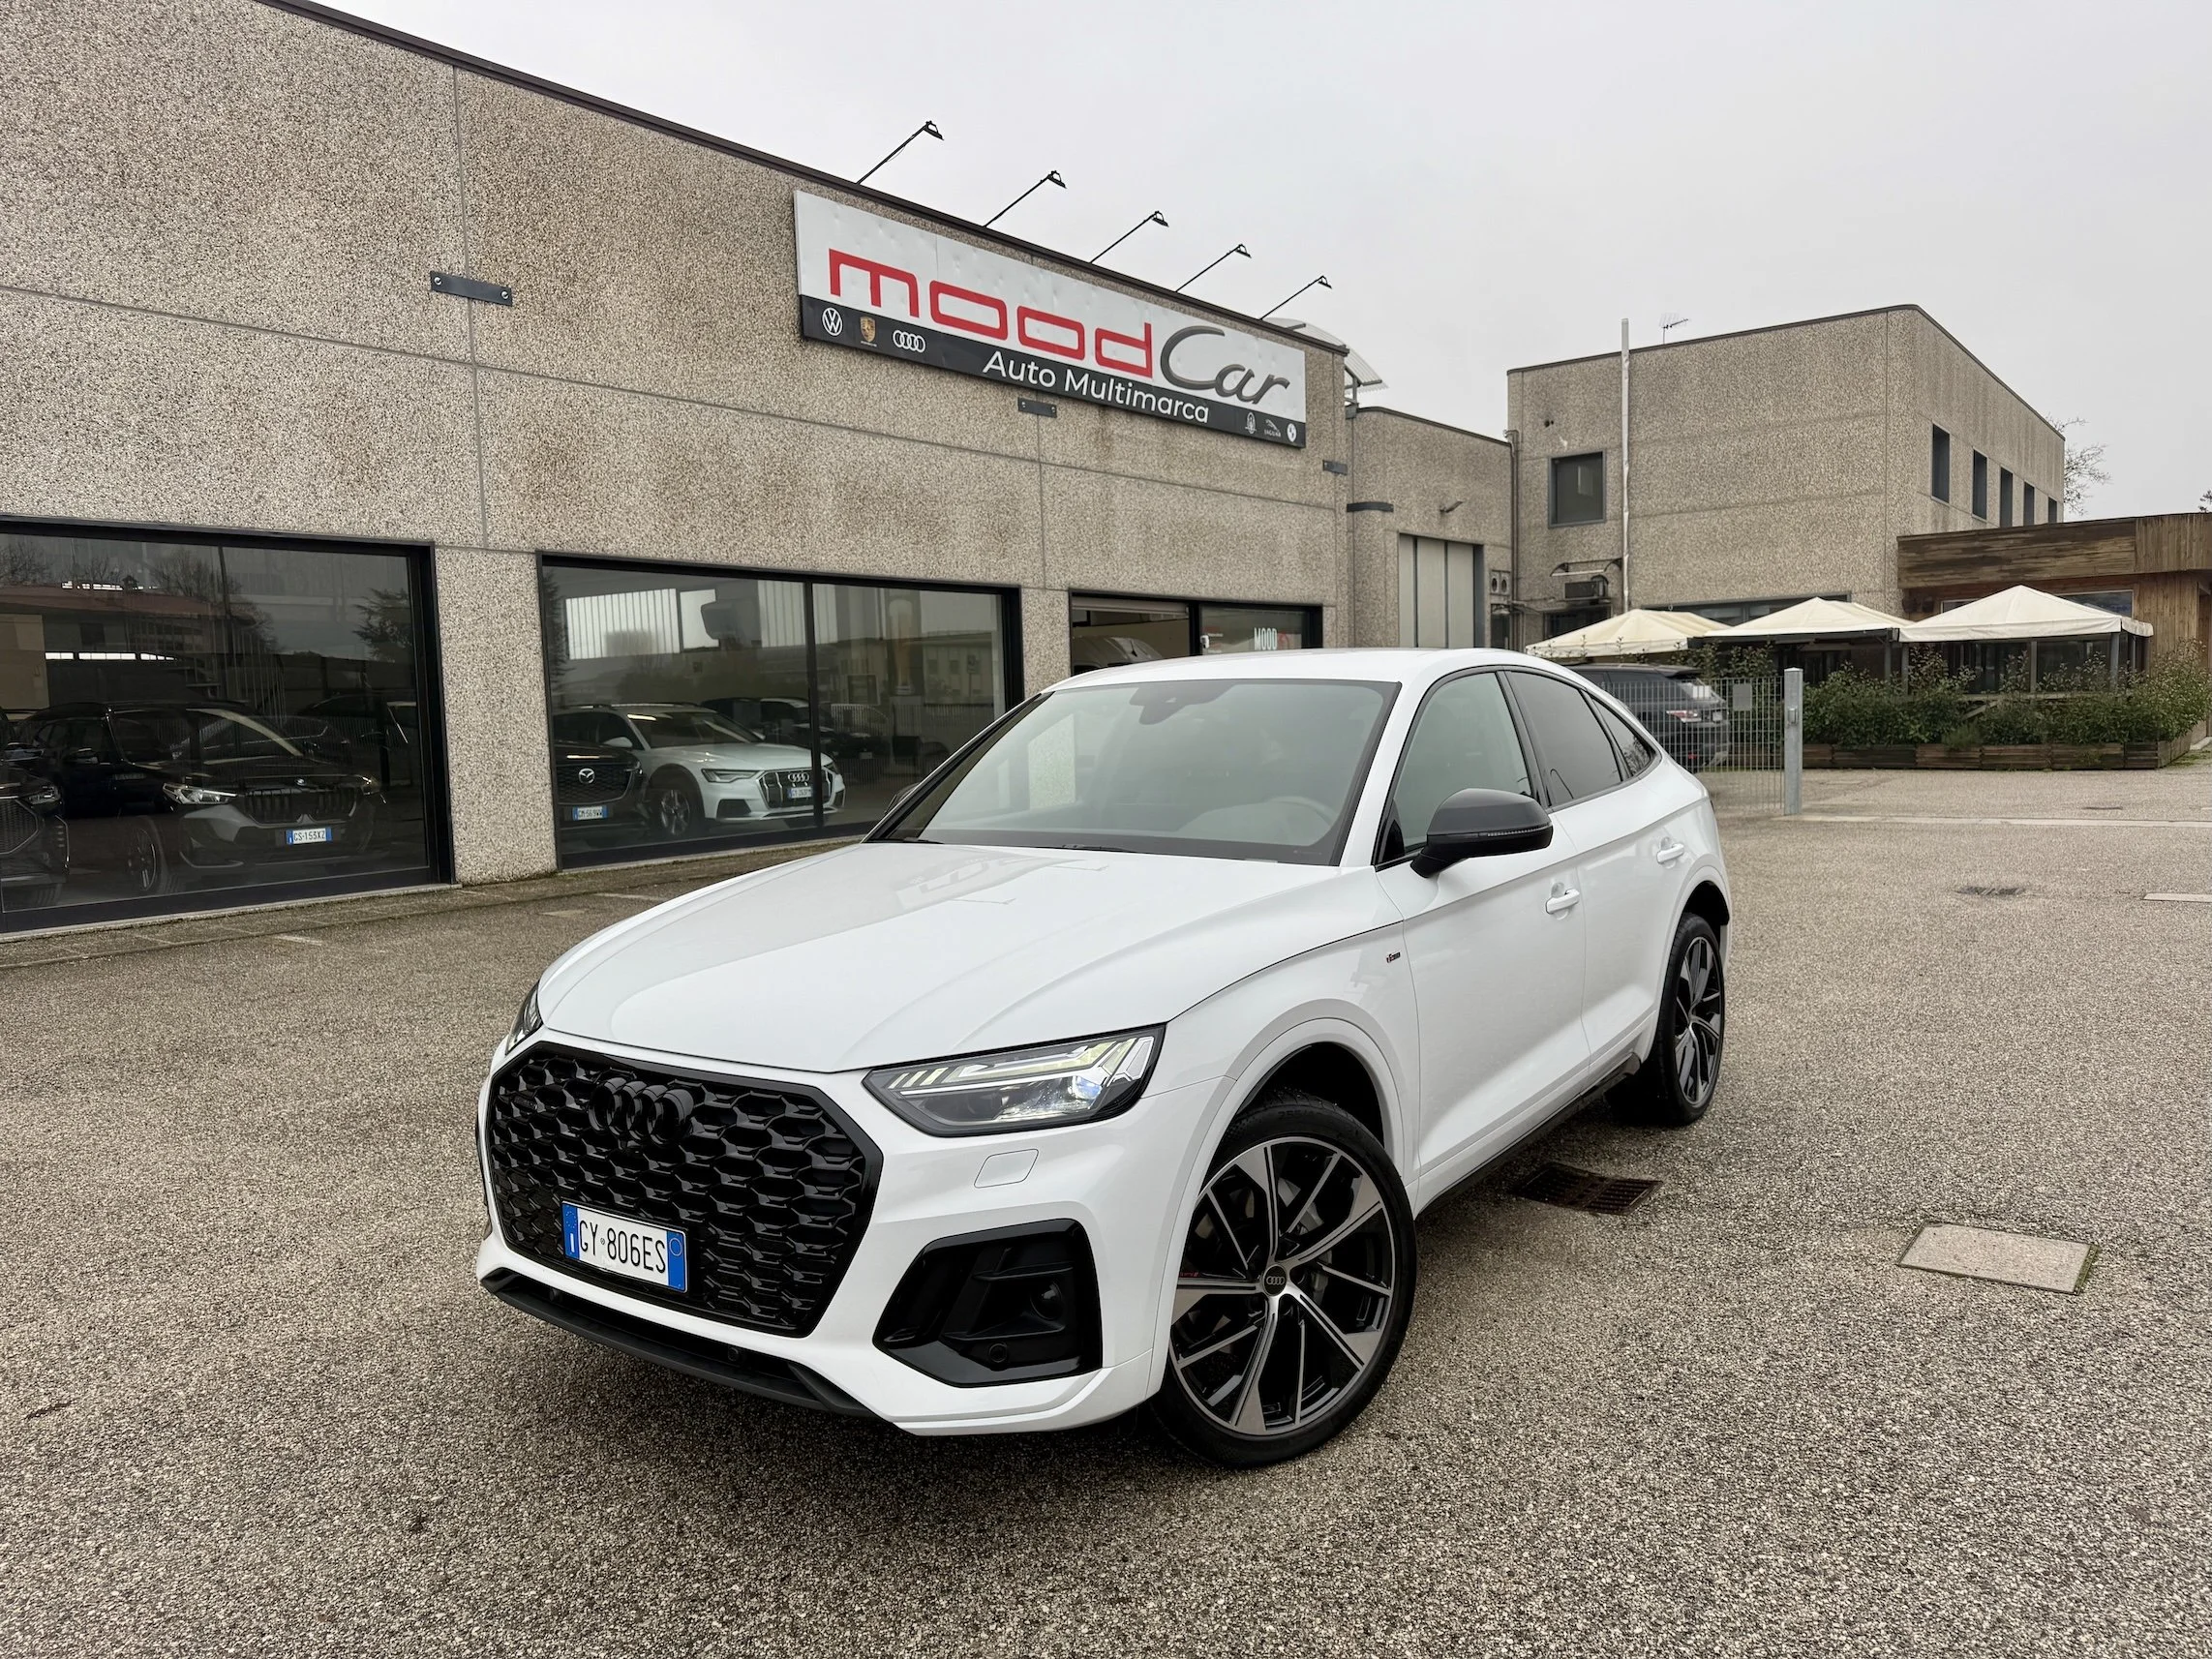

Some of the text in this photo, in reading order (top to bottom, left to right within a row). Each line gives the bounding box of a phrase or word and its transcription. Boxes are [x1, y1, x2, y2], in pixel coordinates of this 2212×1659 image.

[983, 350, 1209, 424] Auto Multimarca
[1254, 627, 1278, 650] MOOD
